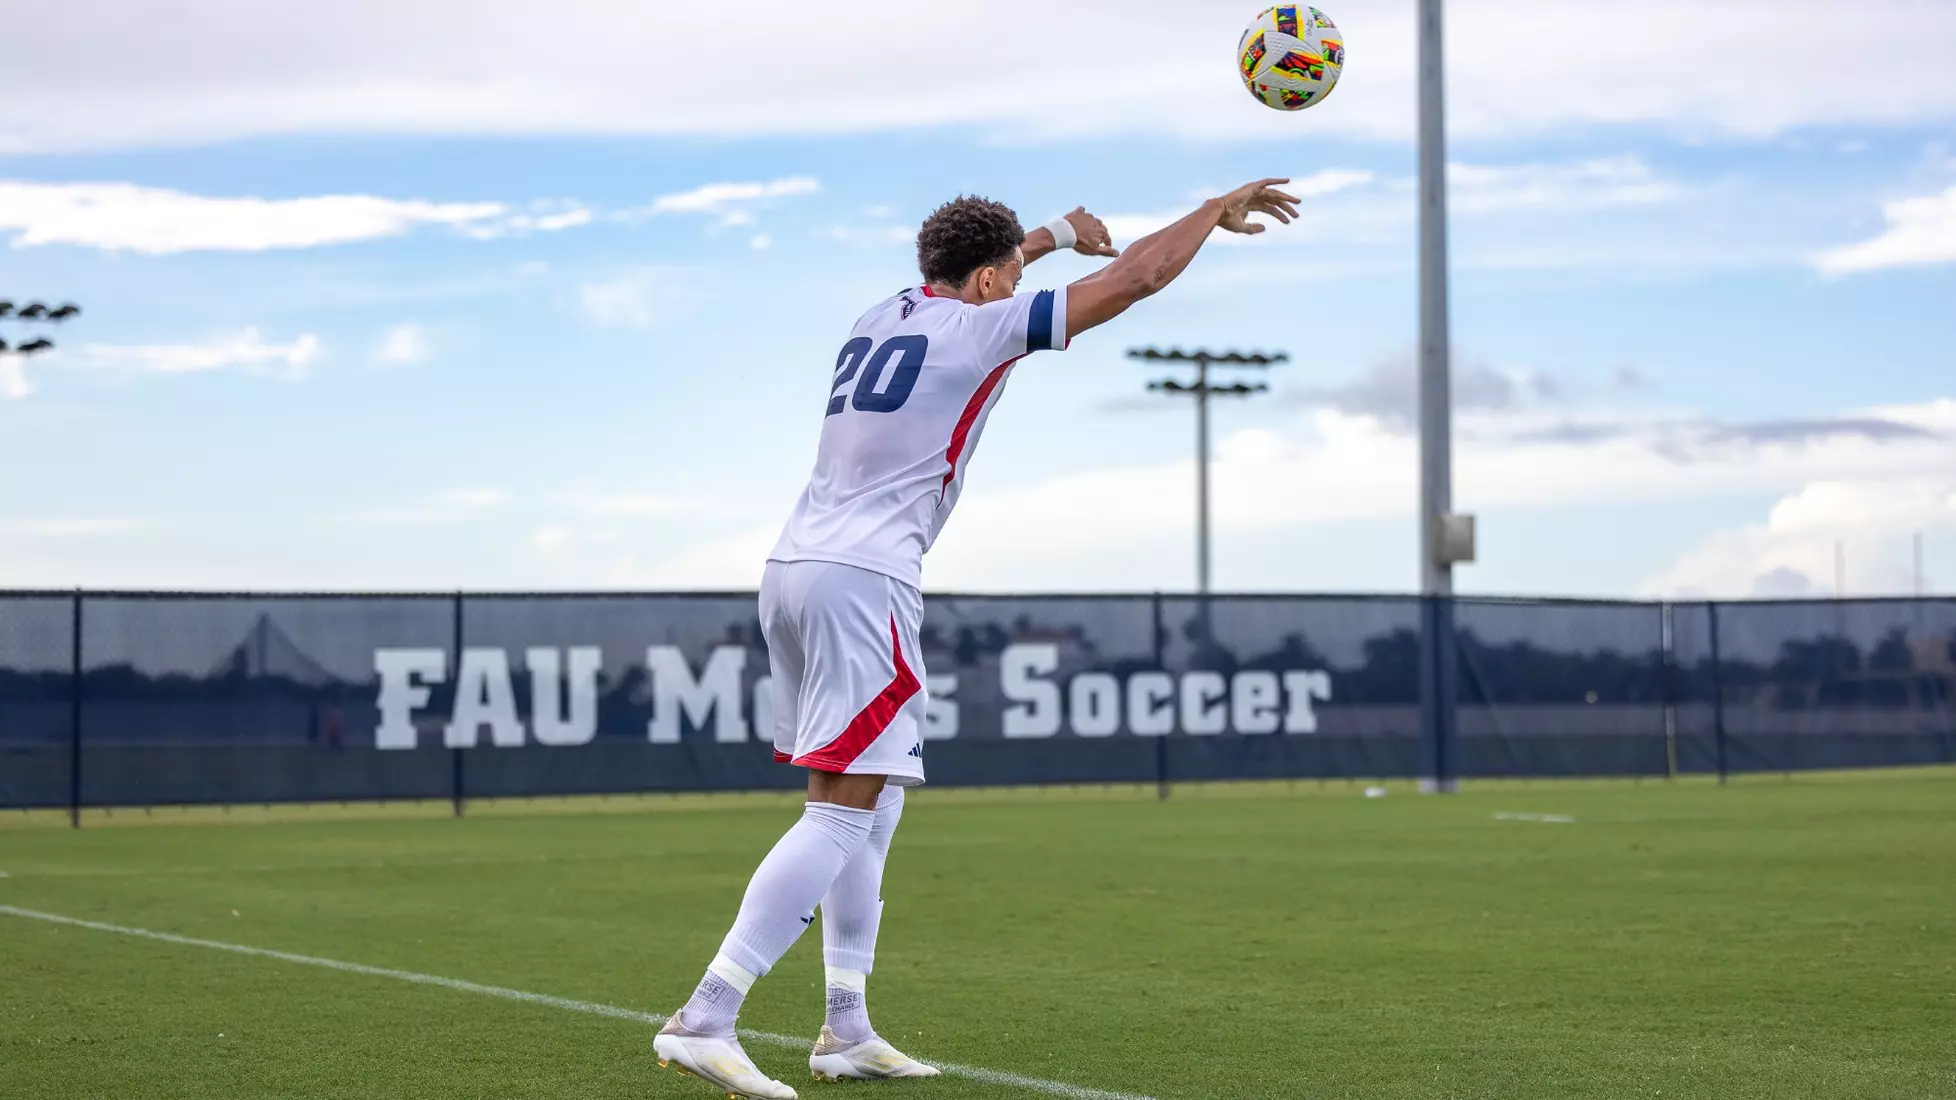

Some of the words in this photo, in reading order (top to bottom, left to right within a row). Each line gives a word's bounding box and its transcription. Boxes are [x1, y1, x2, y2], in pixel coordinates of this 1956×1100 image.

[825, 334, 929, 419] 20
[374, 646, 602, 749] FAU
[1001, 643, 1332, 738] Soccer
